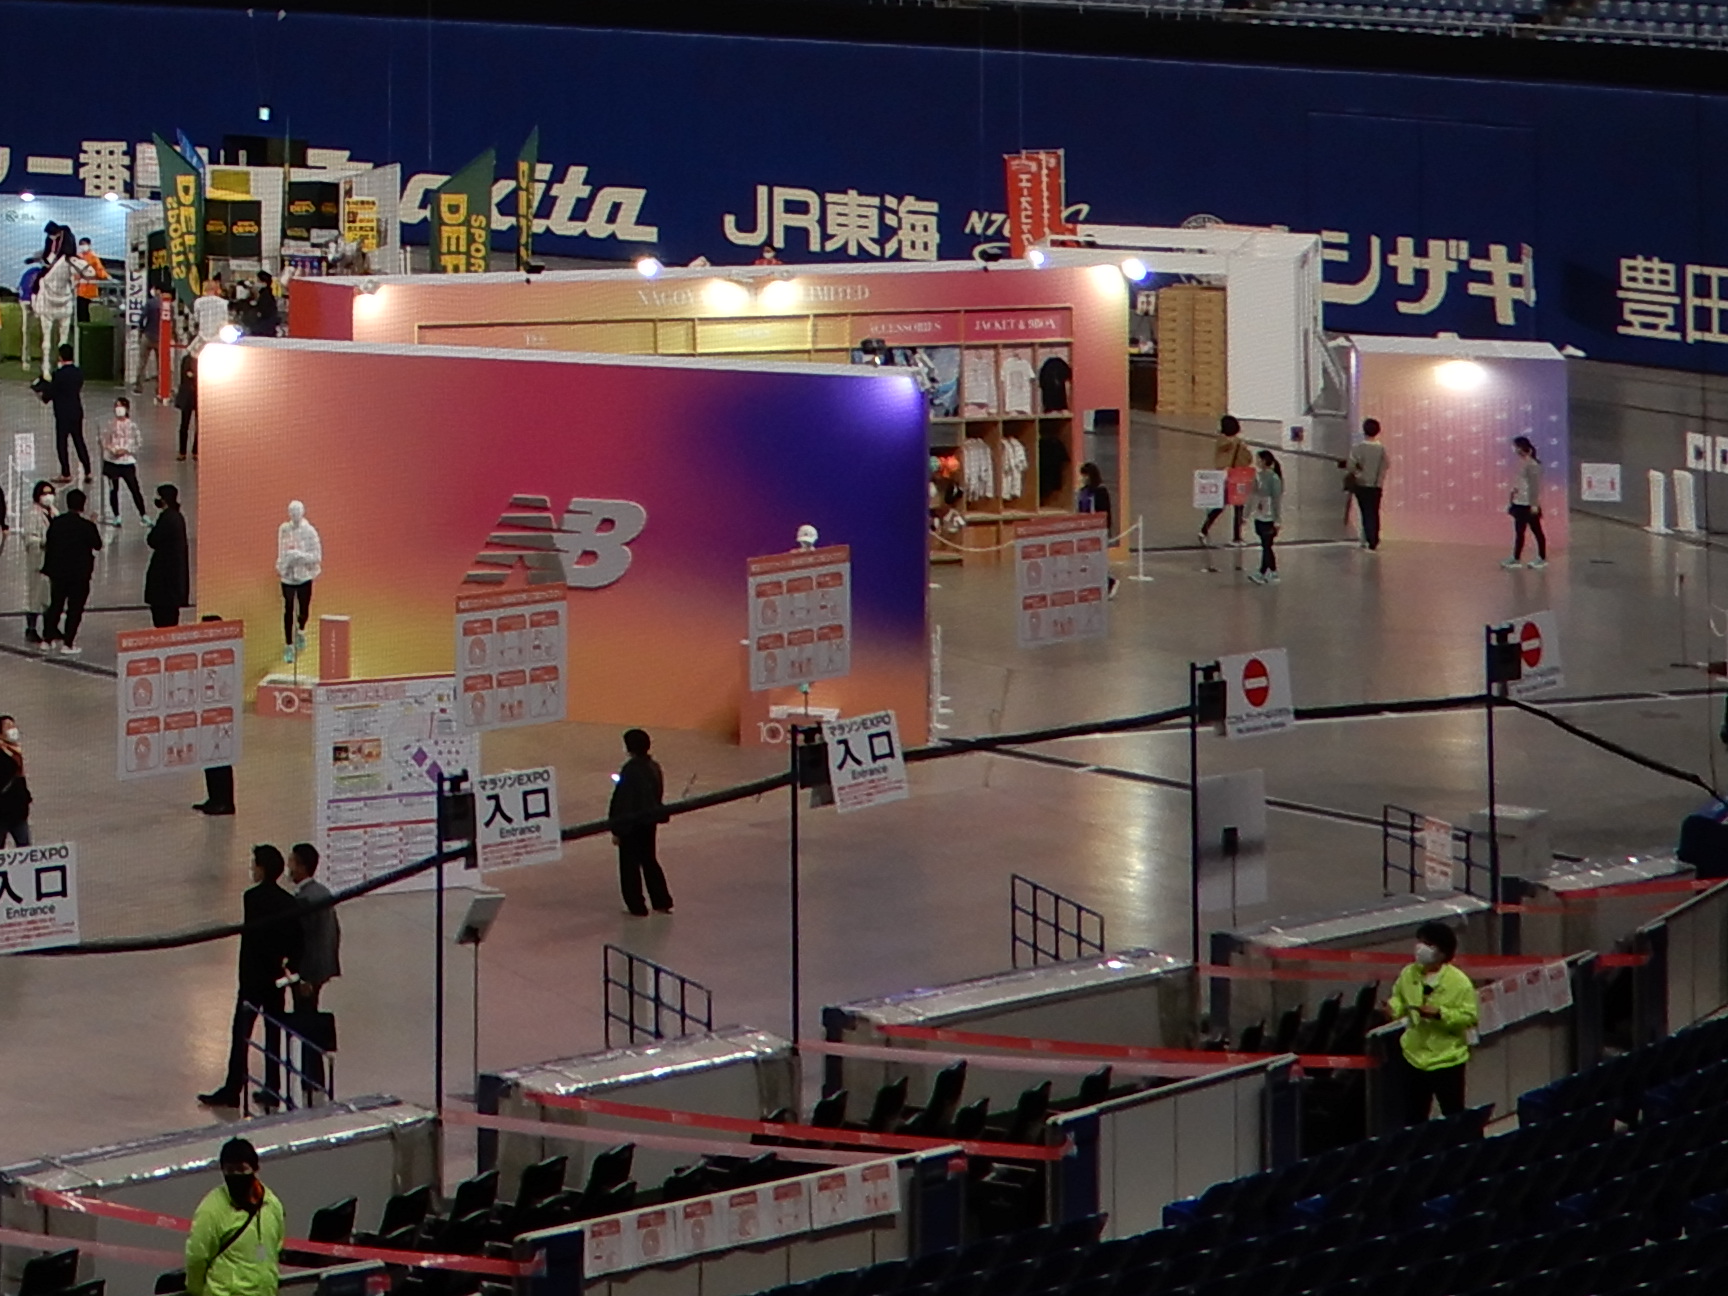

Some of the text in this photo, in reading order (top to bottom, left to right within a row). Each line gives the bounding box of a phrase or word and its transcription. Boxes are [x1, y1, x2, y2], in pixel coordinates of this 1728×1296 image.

[723, 184, 940, 261] JR東海
[828, 714, 892, 738] マラソンEXPO
[836, 730, 896, 771] 入口
[478, 771, 551, 793] マラソンEXPO
[851, 765, 889, 780] Entrance
[483, 787, 551, 829] 入口
[500, 824, 542, 839] Entrance
[6, 904, 57, 920] Entrance
